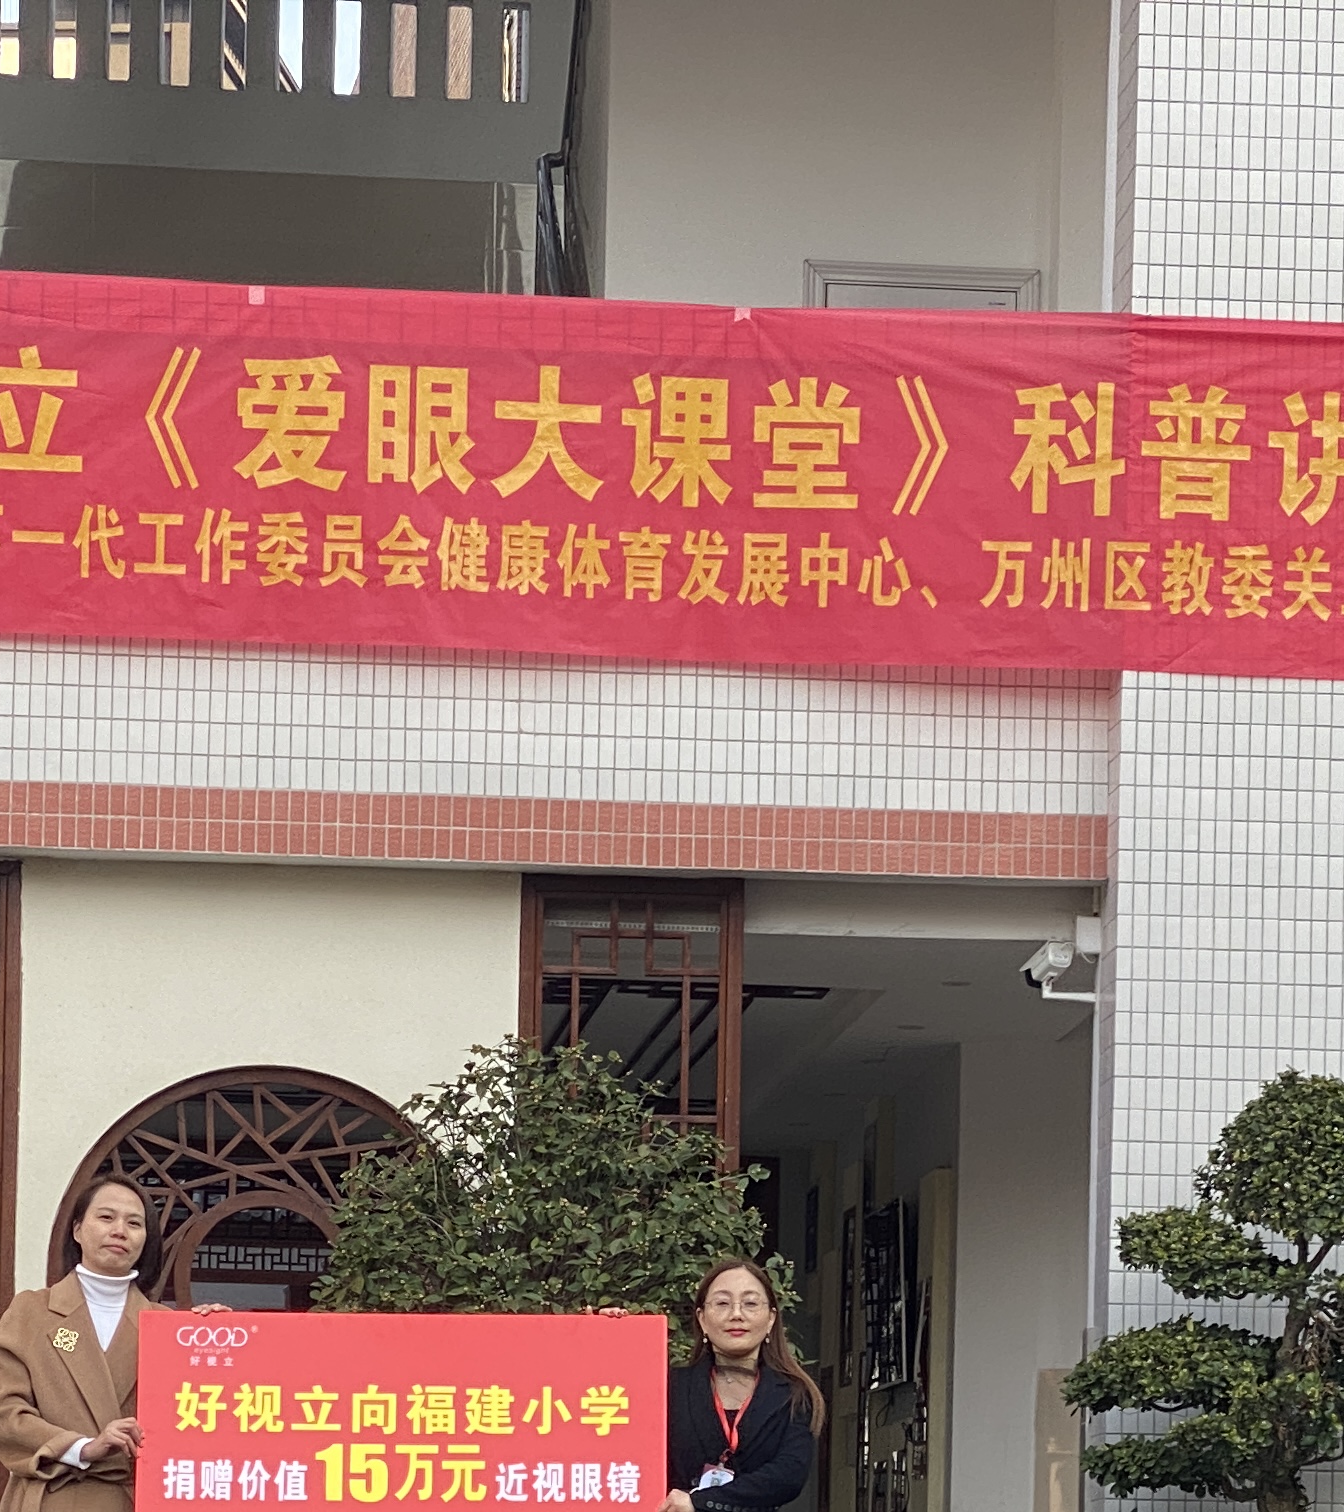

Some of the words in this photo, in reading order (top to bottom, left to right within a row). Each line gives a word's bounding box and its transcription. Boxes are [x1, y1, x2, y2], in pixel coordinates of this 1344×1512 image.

[176, 1326, 249, 1347] GOOD
[174, 1381, 631, 1437] 好视立向福建小学
